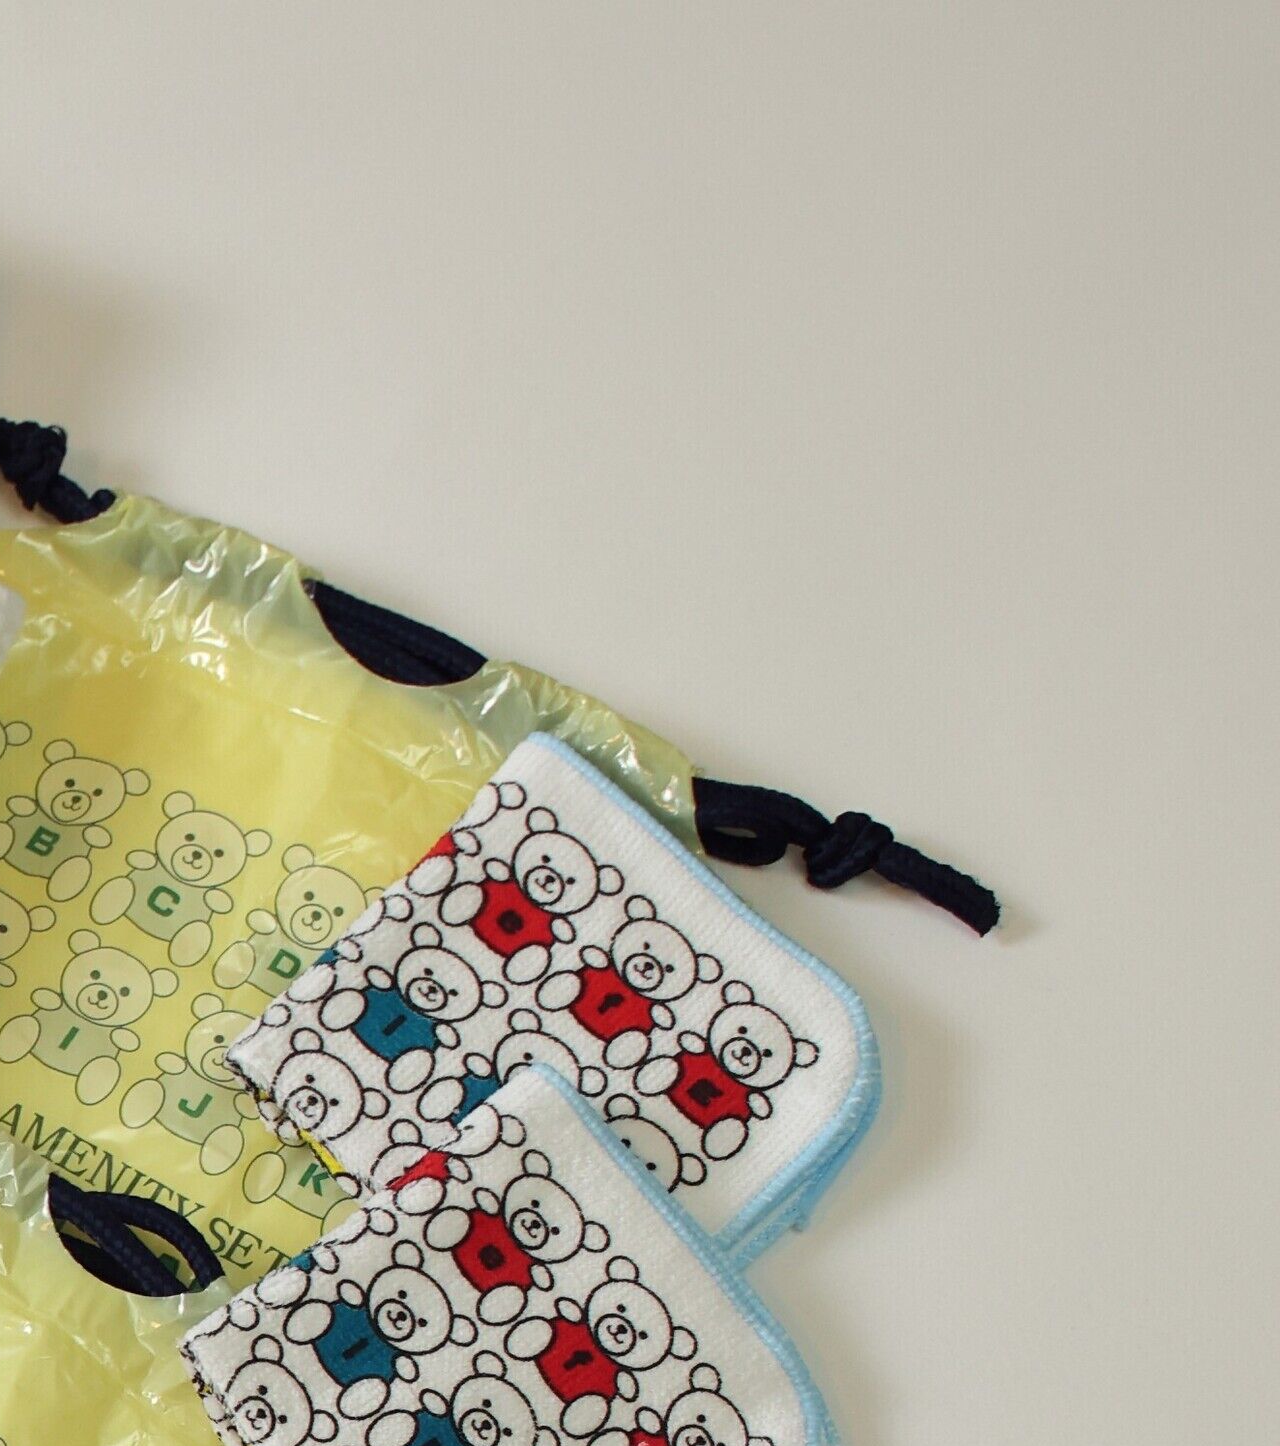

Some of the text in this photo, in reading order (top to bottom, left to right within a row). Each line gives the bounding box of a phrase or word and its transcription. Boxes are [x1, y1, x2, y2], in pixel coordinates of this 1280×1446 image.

[25, 825, 60, 857] B
[147, 885, 182, 918] C
[269, 948, 302, 981] D
[57, 1026, 80, 1052] I
[178, 1093, 214, 1120] J
[298, 1162, 330, 1197] K
